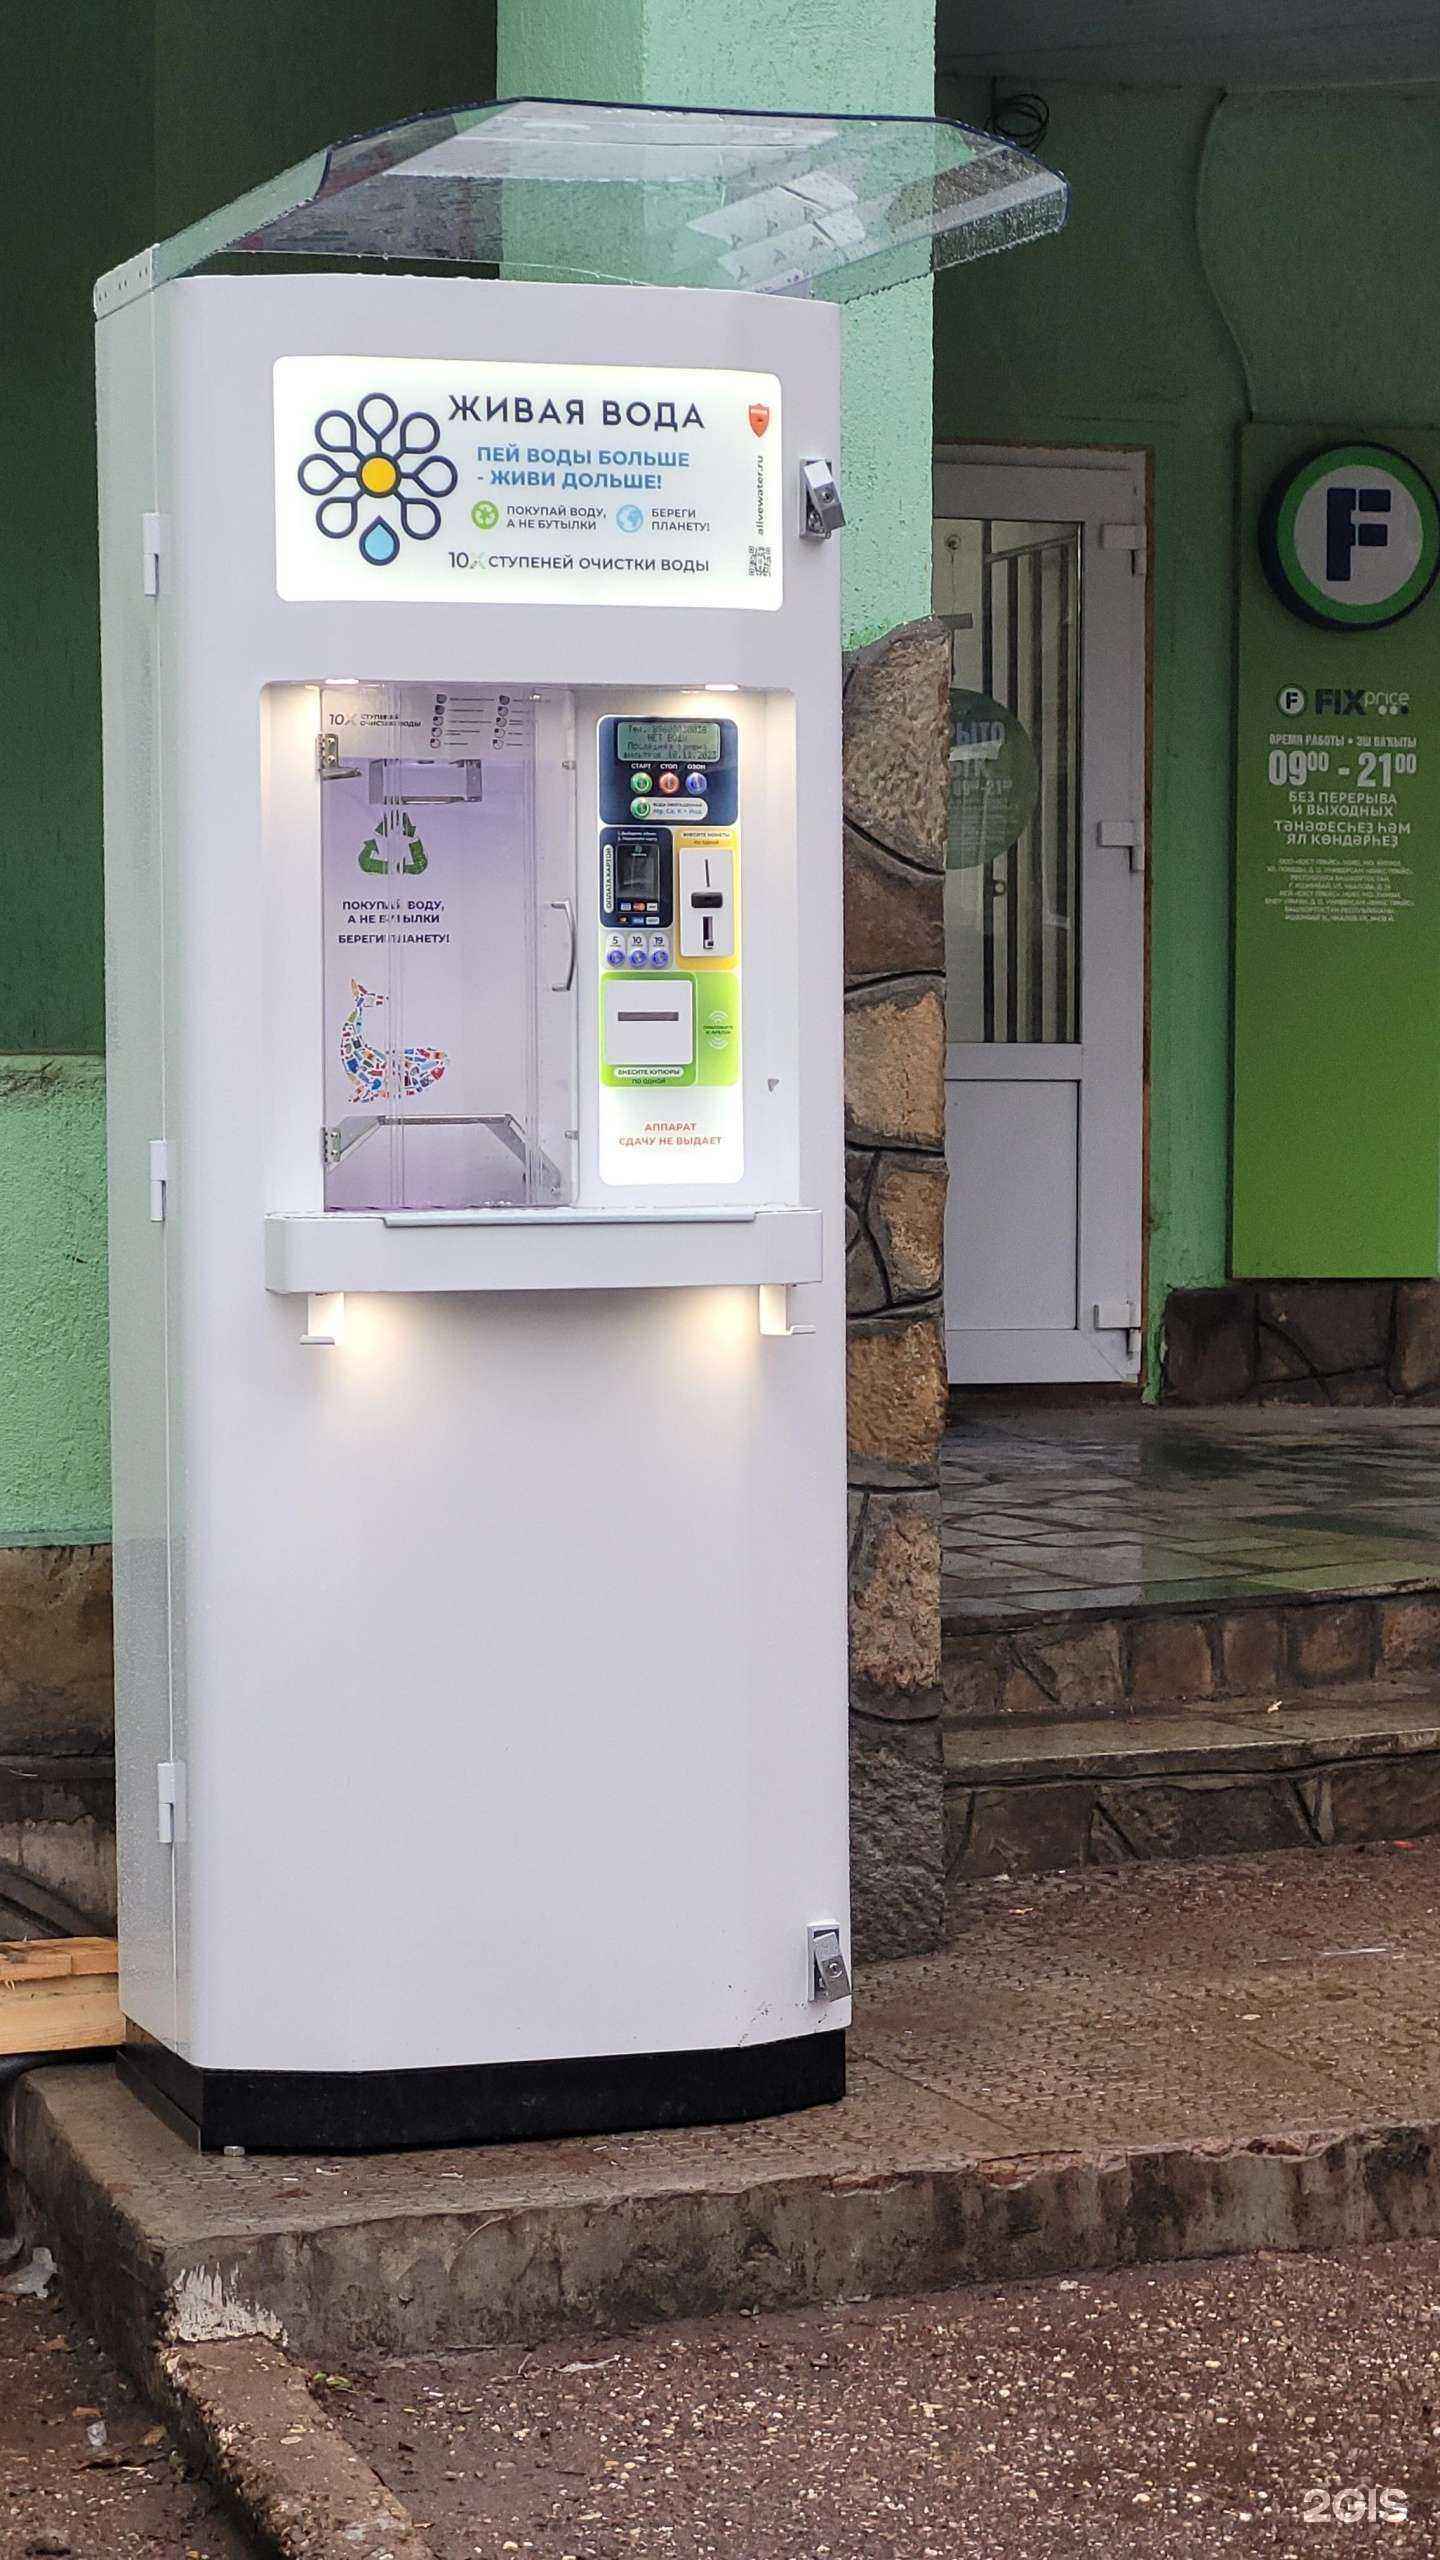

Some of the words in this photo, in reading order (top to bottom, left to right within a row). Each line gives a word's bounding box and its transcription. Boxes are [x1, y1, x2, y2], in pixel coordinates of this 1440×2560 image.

[448, 394, 585, 426] ЖИВАЯ
[602, 399, 706, 432] ВОДА
[477, 443, 520, 463] ПЕЙ
[527, 448, 592, 466] ВОДЫ
[598, 450, 691, 468] БОЛЬШЕ
[490, 470, 556, 487] ЖИВИ
[562, 472, 663, 490] ДОЛЬШЕ!
[507, 503, 566, 517] ПОКУПАЙ
[570, 507, 608, 520] ВОДУ,
[651, 507, 697, 519] БЕРЕГИ
[506, 520, 516, 529] А
[519, 519, 534, 529] НЕ
[538, 519, 598, 531] БУТЫЛКИ
[651, 521, 711, 533] ПЛАНЕТУ!
[1326, 487, 1392, 582] F
[488, 554, 573, 570] СТУПЕНЕЙ
[579, 557, 655, 571] ОЧИСТКИ
[661, 559, 709, 574] ВОДЫ
[1305, 734, 1344, 746] РАБОТЫ
[1289, 791, 1314, 802] БЕЗ
[1319, 792, 1397, 804] ПЕРЕРЫВА
[1293, 805, 1302, 815] И
[1307, 805, 1394, 818] ВЫХОДНЫХ
[1287, 834, 1306, 845] ЯЛ
[408, 901, 444, 911] ВОДУ,
[348, 915, 356, 923] А
[360, 915, 376, 923] НЕ
[338, 934, 384, 944] БЕРЕГИ
[644, 1123, 697, 1131] АППАРАТ
[619, 1137, 655, 1146] СДАЧУ
[659, 1137, 673, 1145] НЕ
[676, 1137, 722, 1145] ВЫДАЕТ
